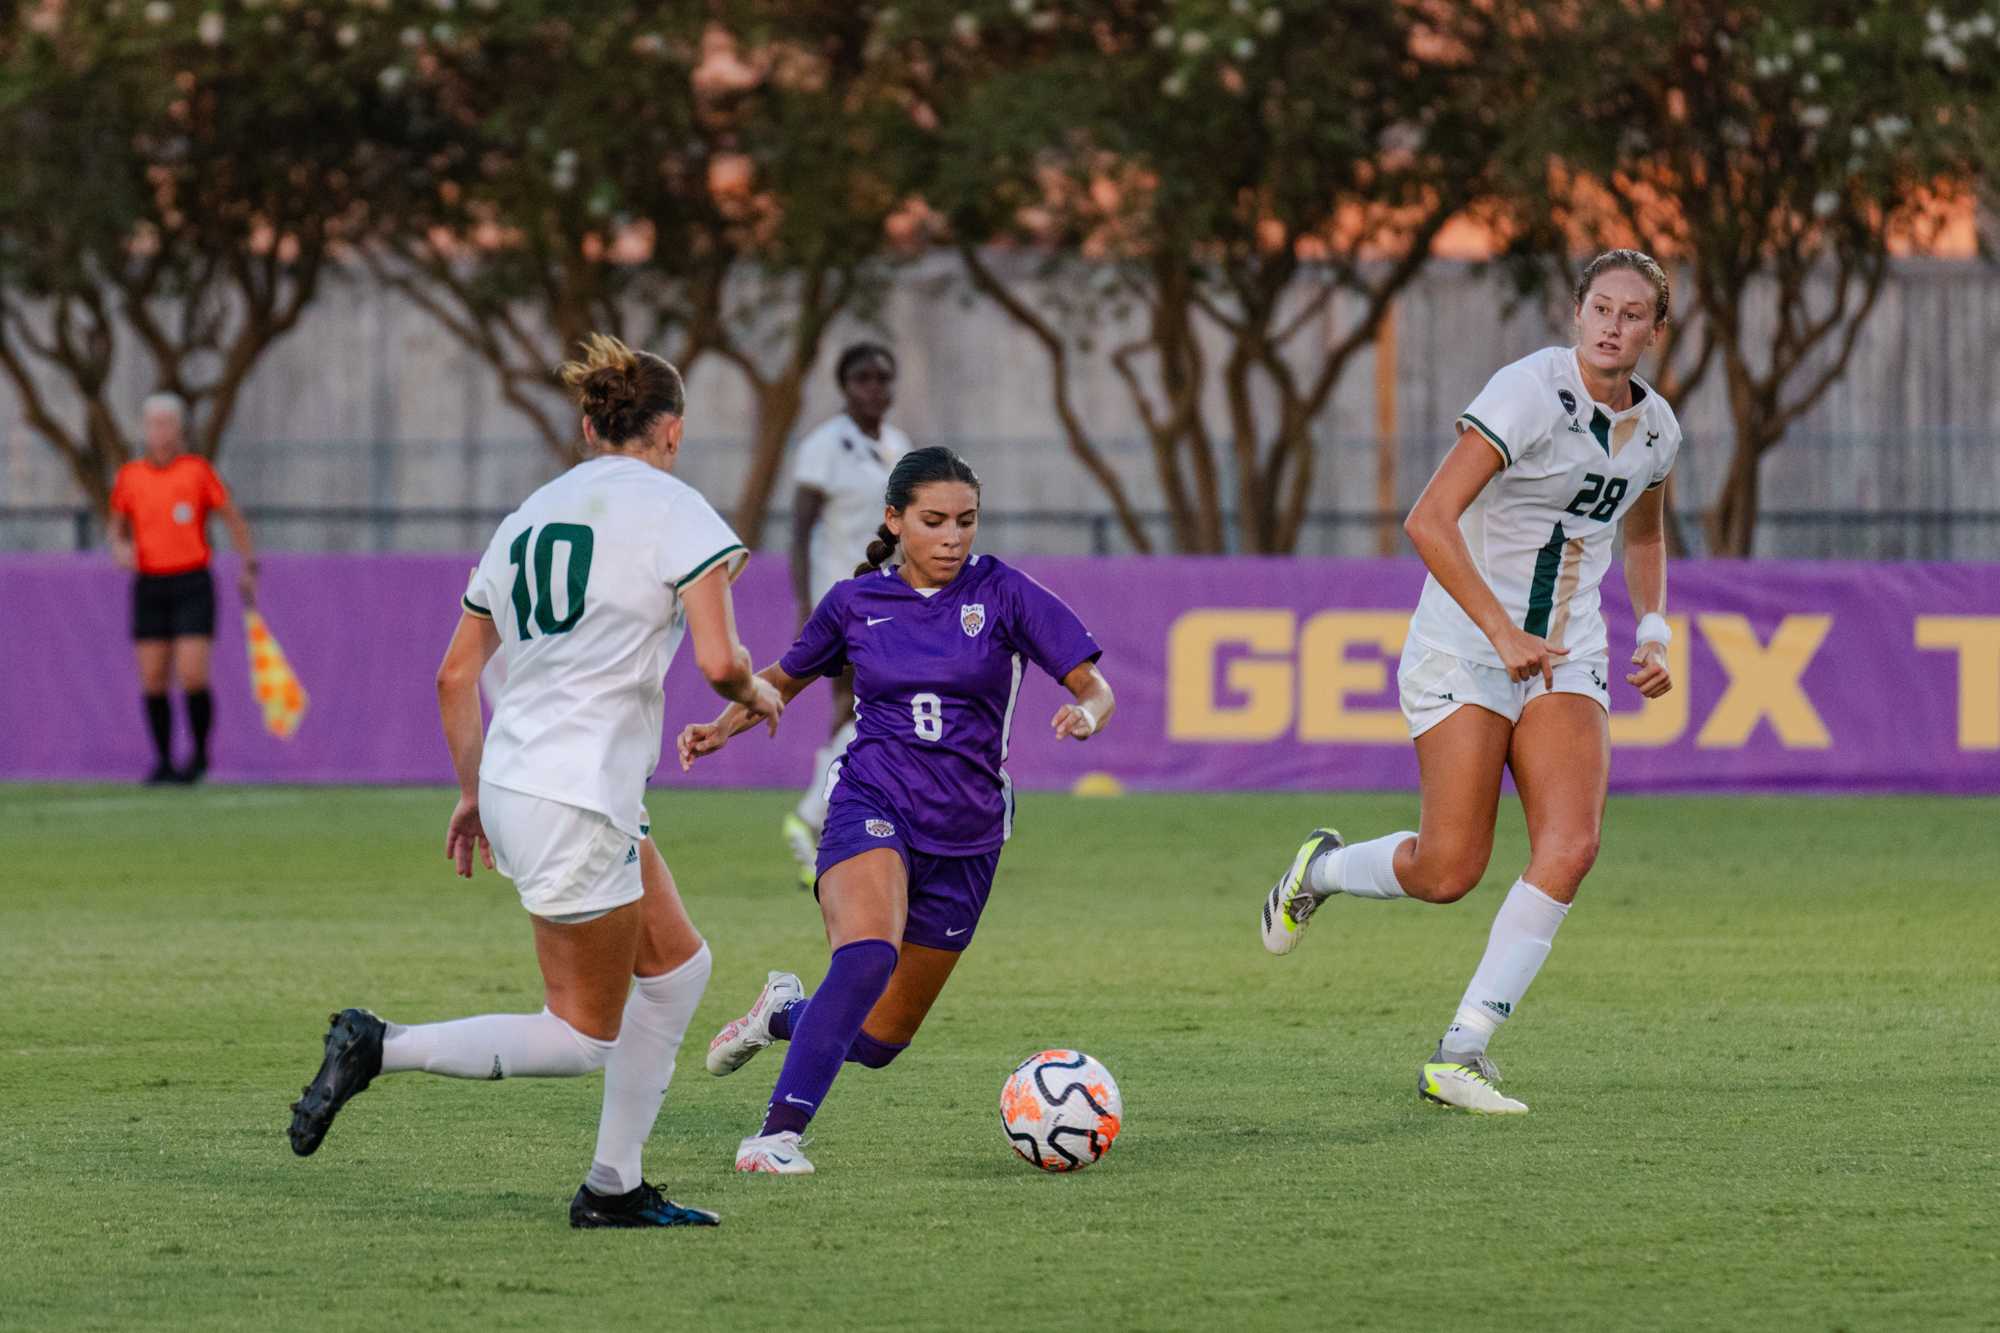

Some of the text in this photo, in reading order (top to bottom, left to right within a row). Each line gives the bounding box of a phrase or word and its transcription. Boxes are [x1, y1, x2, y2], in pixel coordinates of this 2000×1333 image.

[1564, 472, 1629, 523] 28
[510, 522, 594, 641] 10
[911, 692, 943, 743] 8
[1168, 610, 1834, 750] GEUX
